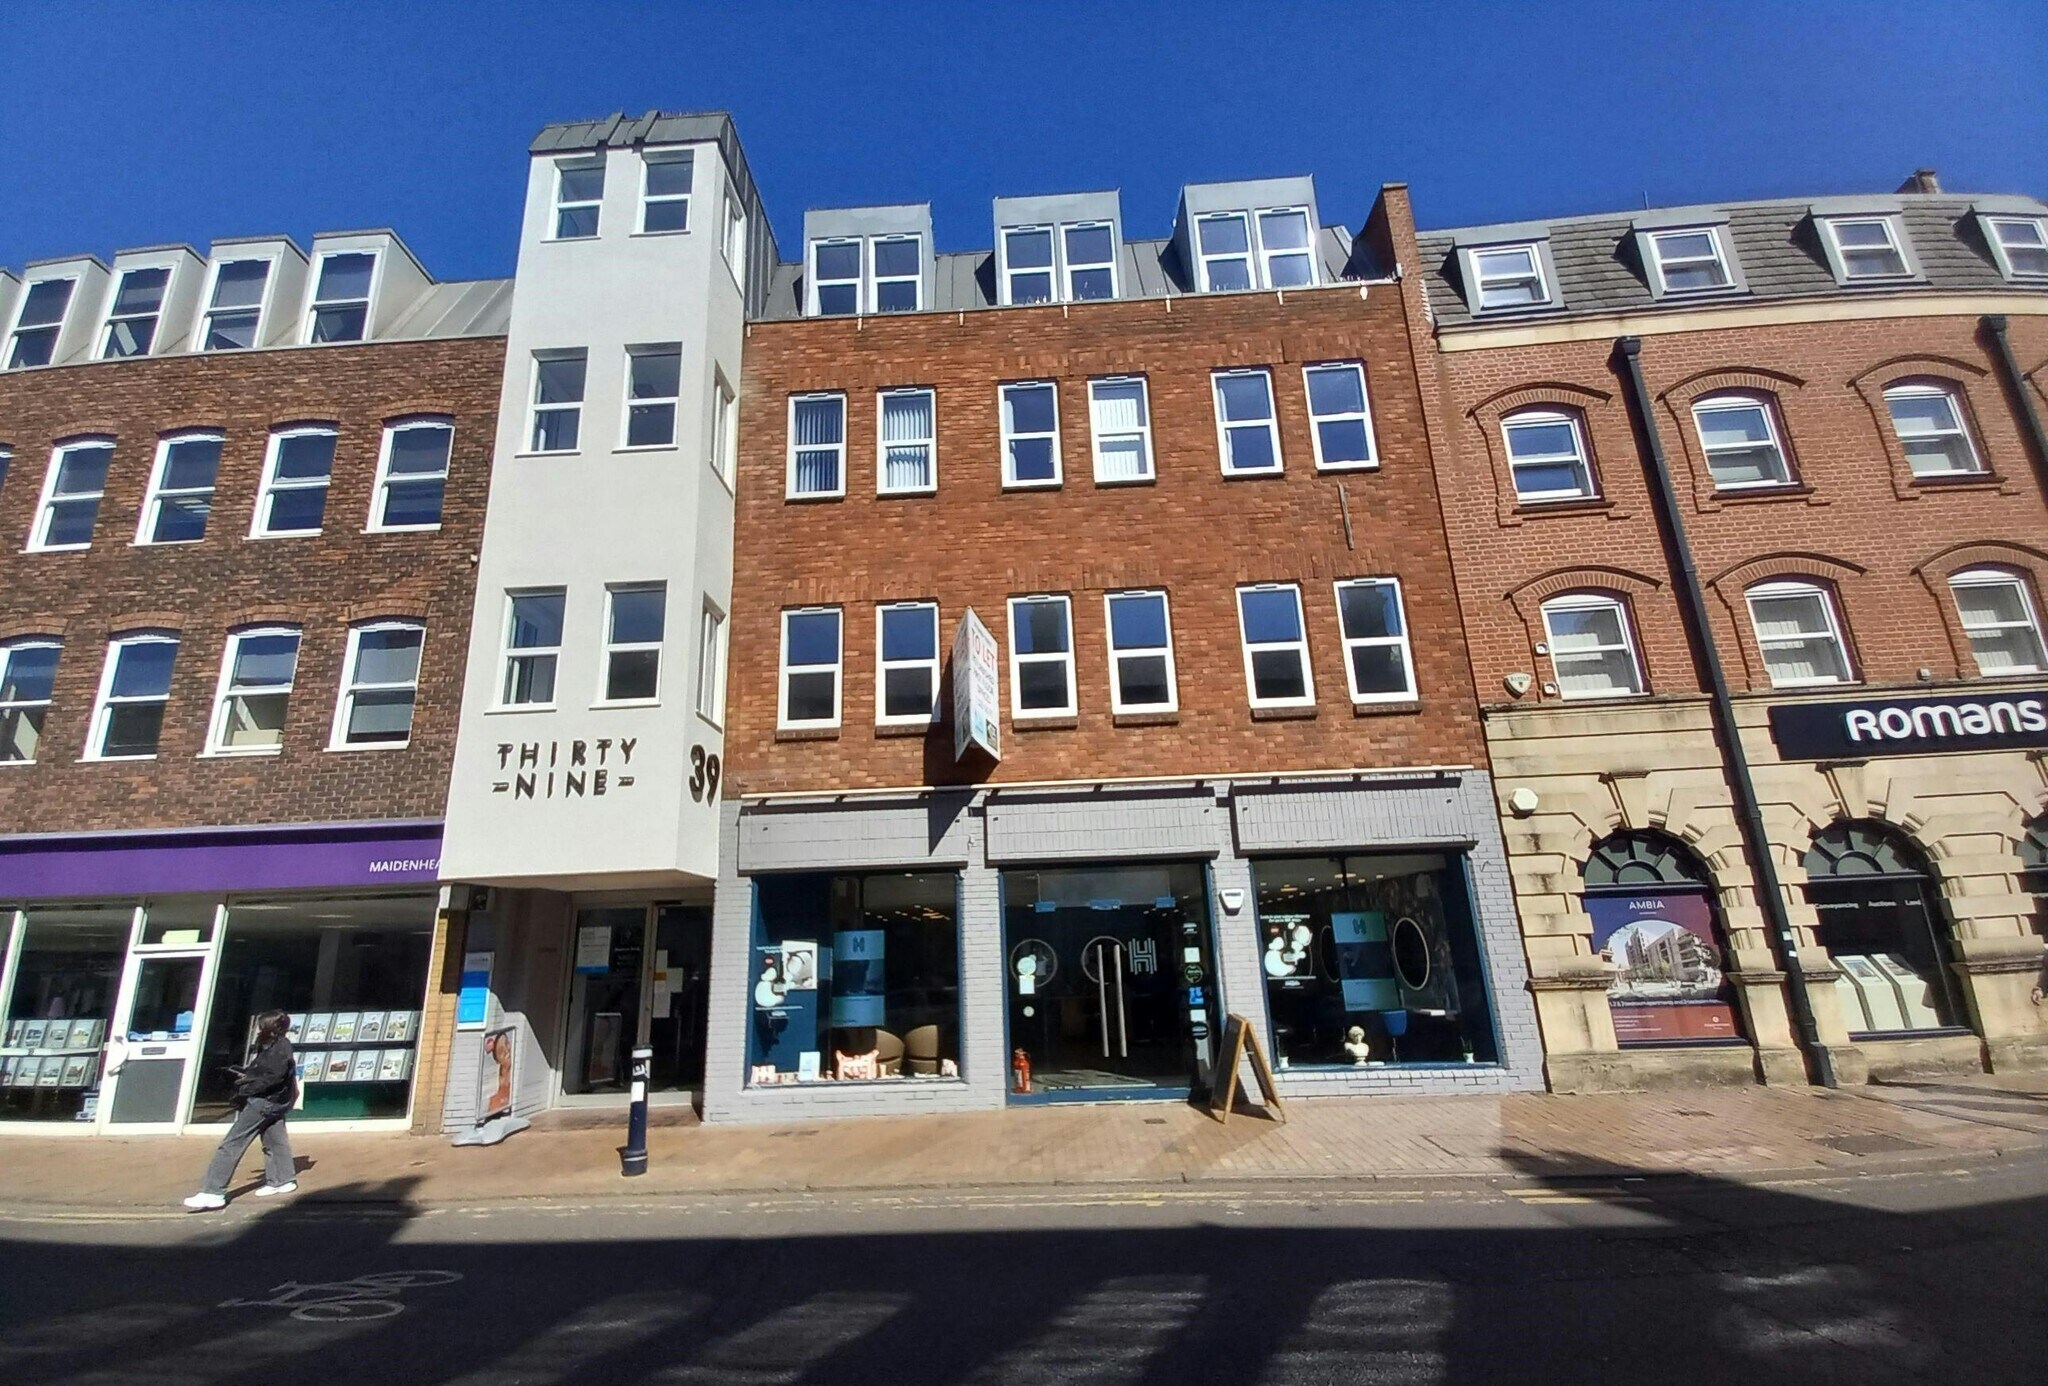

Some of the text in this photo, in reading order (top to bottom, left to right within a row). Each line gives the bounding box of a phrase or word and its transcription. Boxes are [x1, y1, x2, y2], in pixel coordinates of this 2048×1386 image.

[497, 737, 638, 770] THIRTY
[689, 744, 720, 808] 39
[1629, 899, 1665, 911] AMBIA
